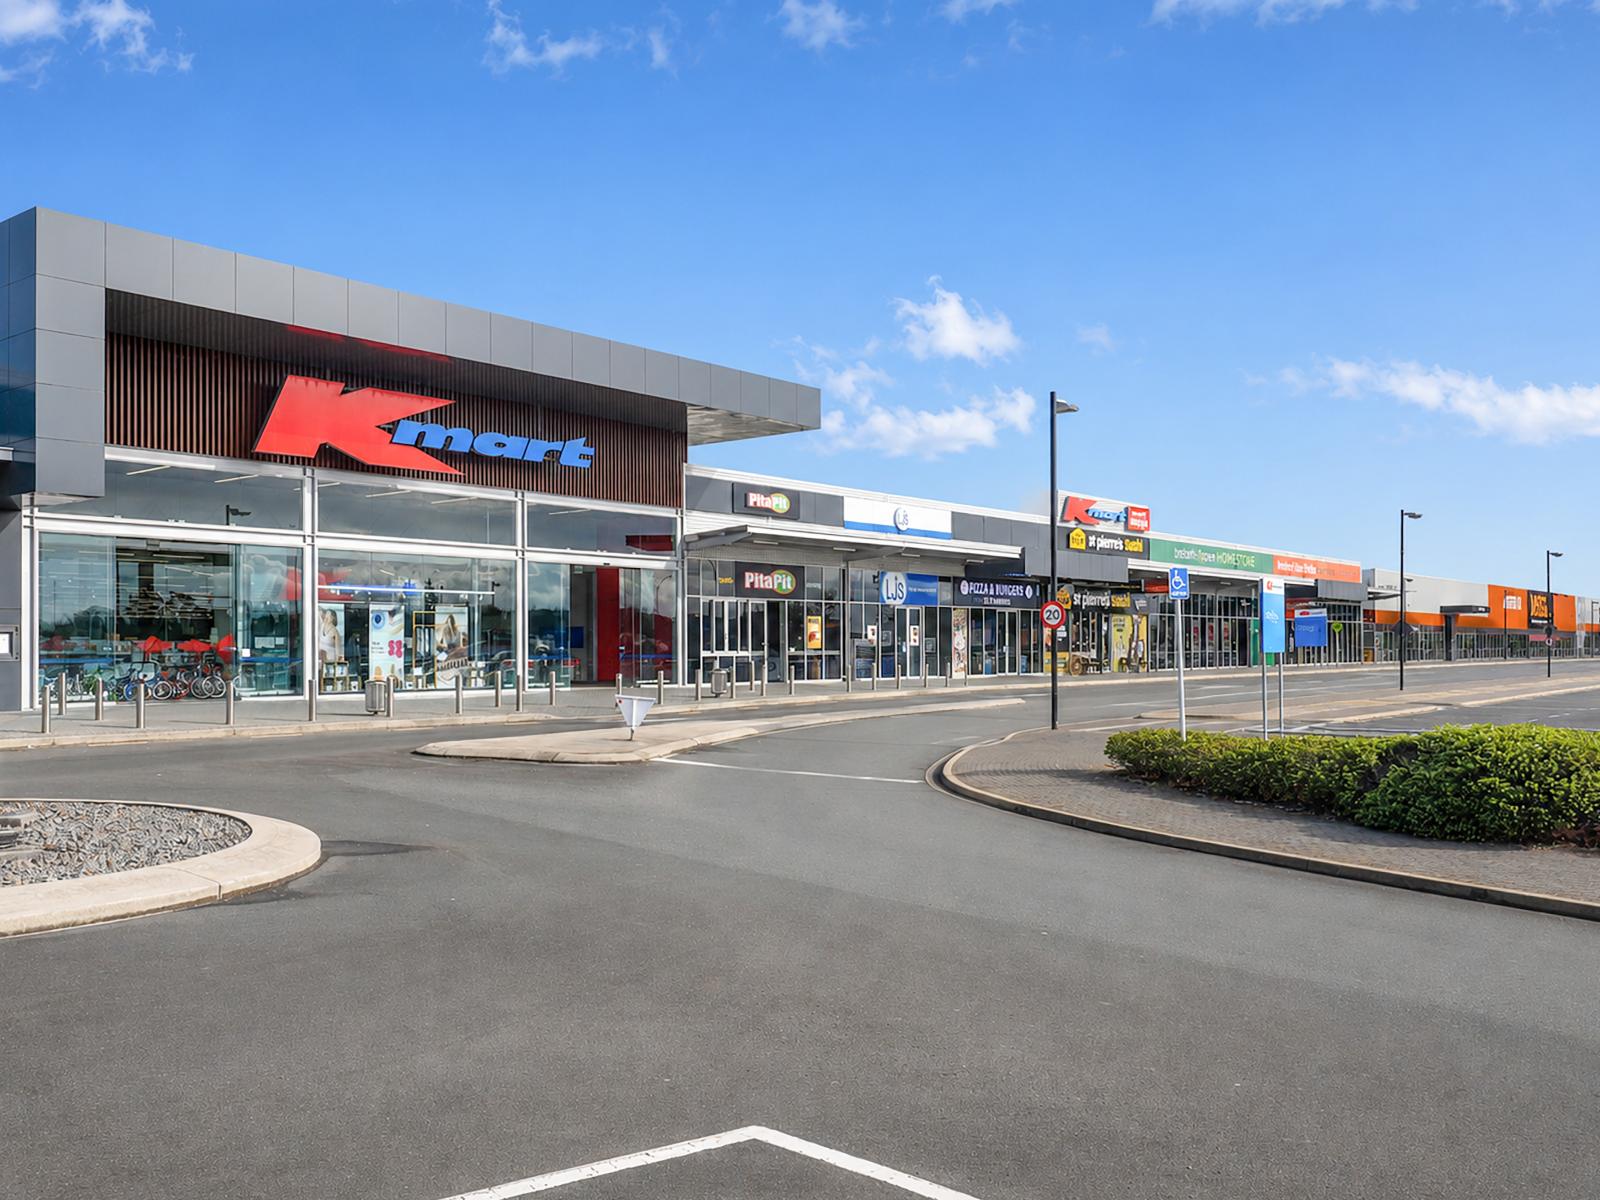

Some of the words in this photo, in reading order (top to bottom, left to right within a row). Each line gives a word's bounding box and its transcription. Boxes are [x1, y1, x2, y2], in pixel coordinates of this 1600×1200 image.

[253, 374, 595, 475] Kmart
[1063, 496, 1127, 525] Kmart
[1045, 609, 1060, 620] 20
